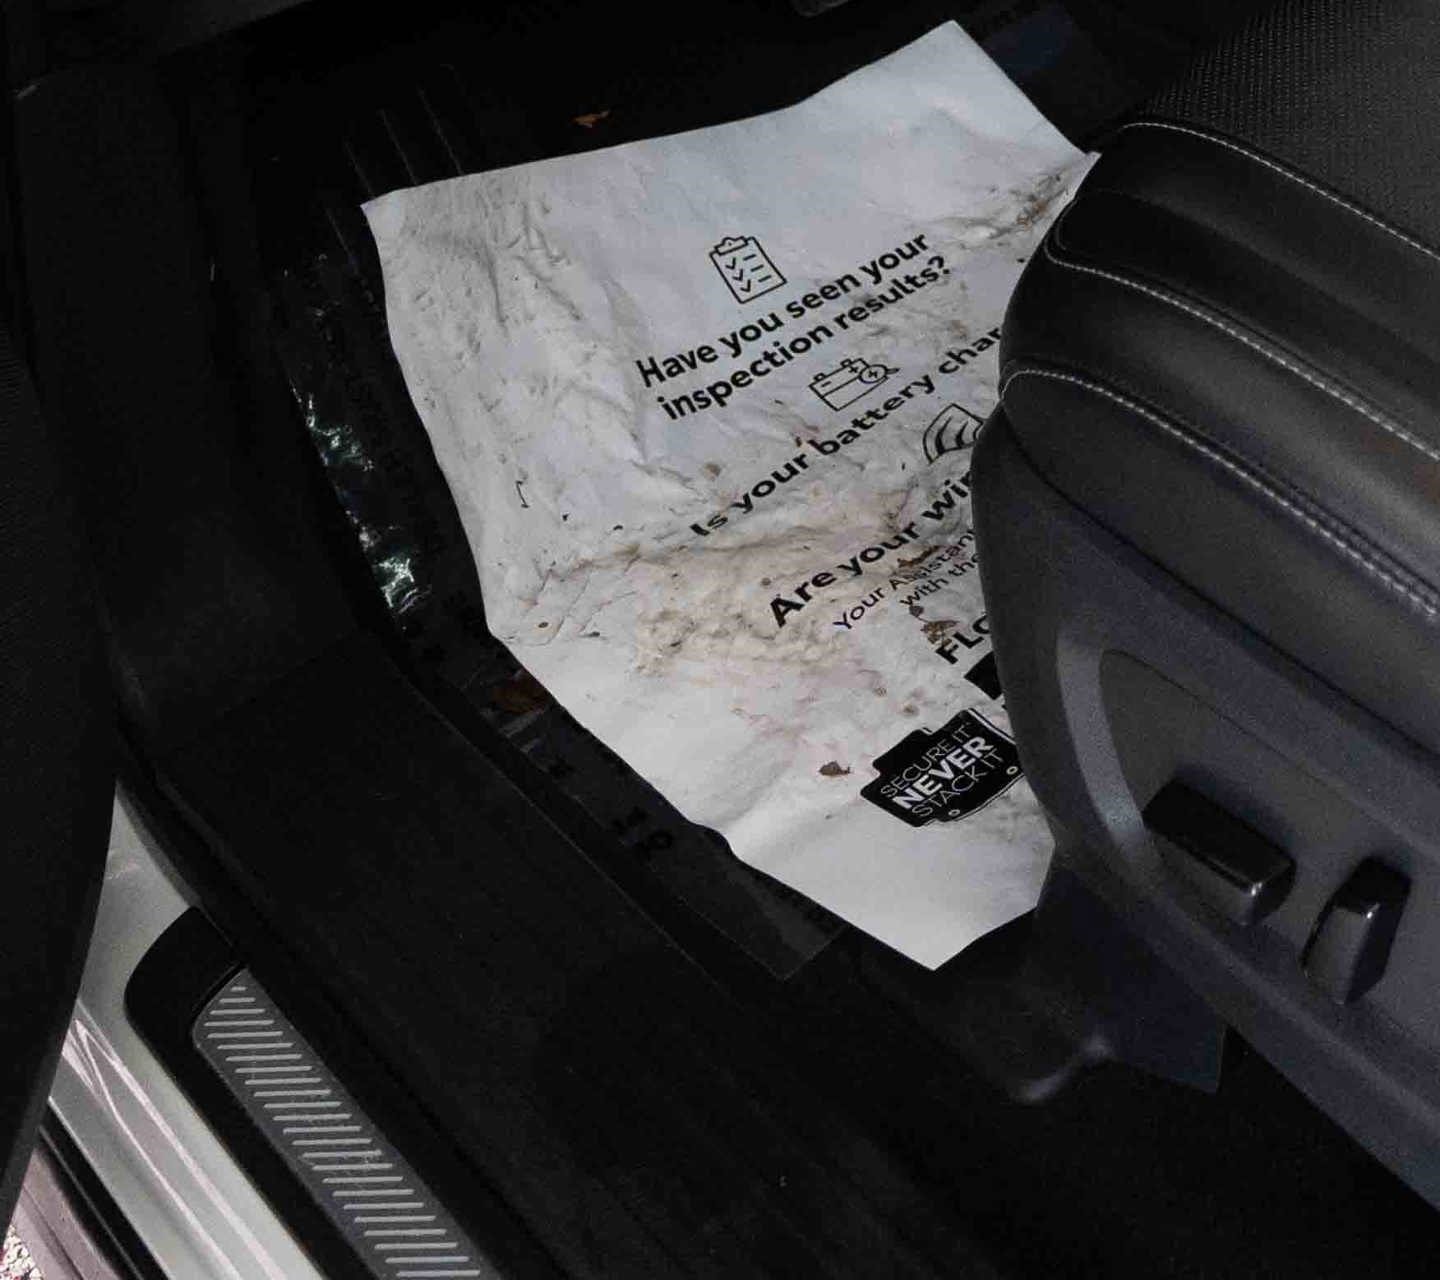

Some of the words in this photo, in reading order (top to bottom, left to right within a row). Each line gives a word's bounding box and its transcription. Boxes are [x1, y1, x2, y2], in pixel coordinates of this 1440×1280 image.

[636, 339, 718, 388] Have
[717, 312, 784, 359] you
[785, 273, 860, 319] seen
[858, 234, 930, 285] your
[657, 326, 834, 421] inspection
[833, 255, 951, 330] results?
[690, 514, 728, 537] Is
[731, 453, 811, 513] your
[809, 373, 936, 457] battery
[770, 570, 838, 629] Are
[836, 521, 921, 577] your
[833, 586, 887, 631] Your
[900, 577, 950, 606] with
[880, 739, 954, 799] SECURE
[892, 736, 995, 811] NEVER
[911, 765, 988, 818] STACK
[980, 747, 1004, 770] IT
